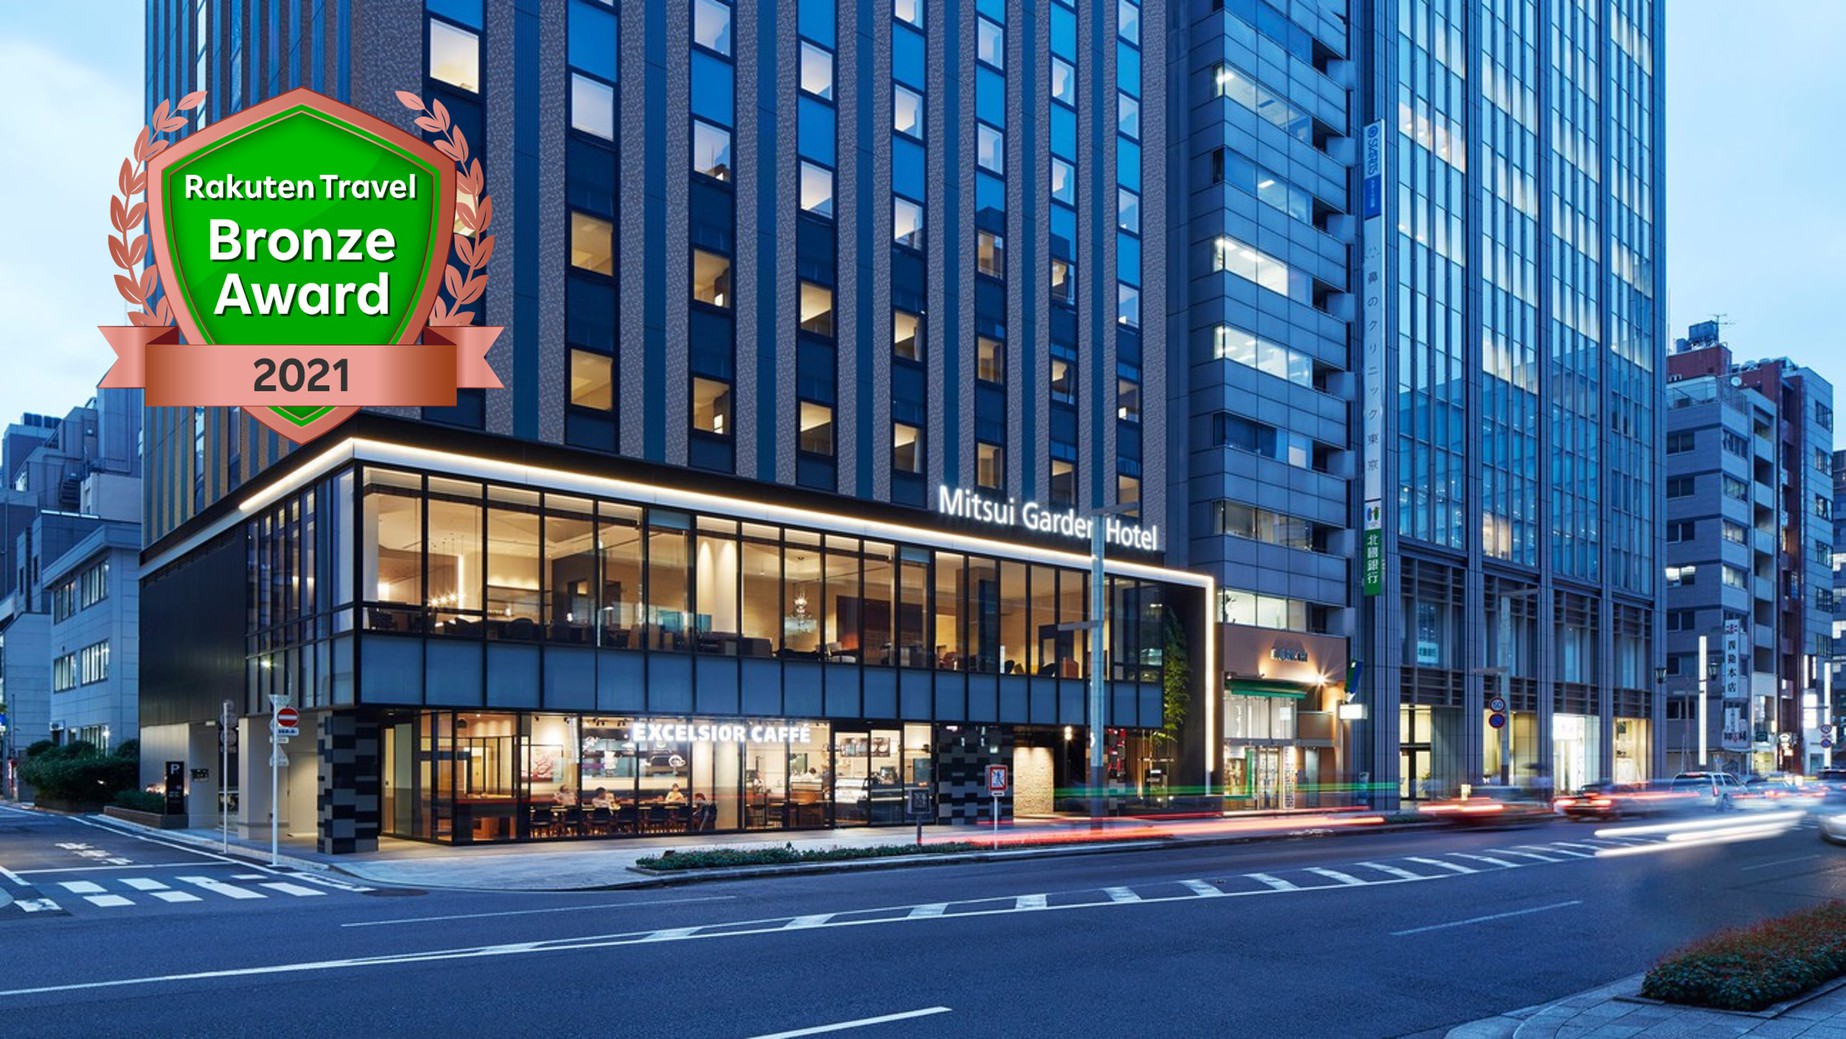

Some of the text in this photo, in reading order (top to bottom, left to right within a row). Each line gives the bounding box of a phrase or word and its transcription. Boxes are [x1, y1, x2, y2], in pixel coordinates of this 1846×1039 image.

[938, 484, 1015, 526] Mitsui
[1106, 517, 1158, 551] Hotel
[632, 723, 811, 743] EXCELSIOR CAFFÉ
[171, 764, 180, 775] P
